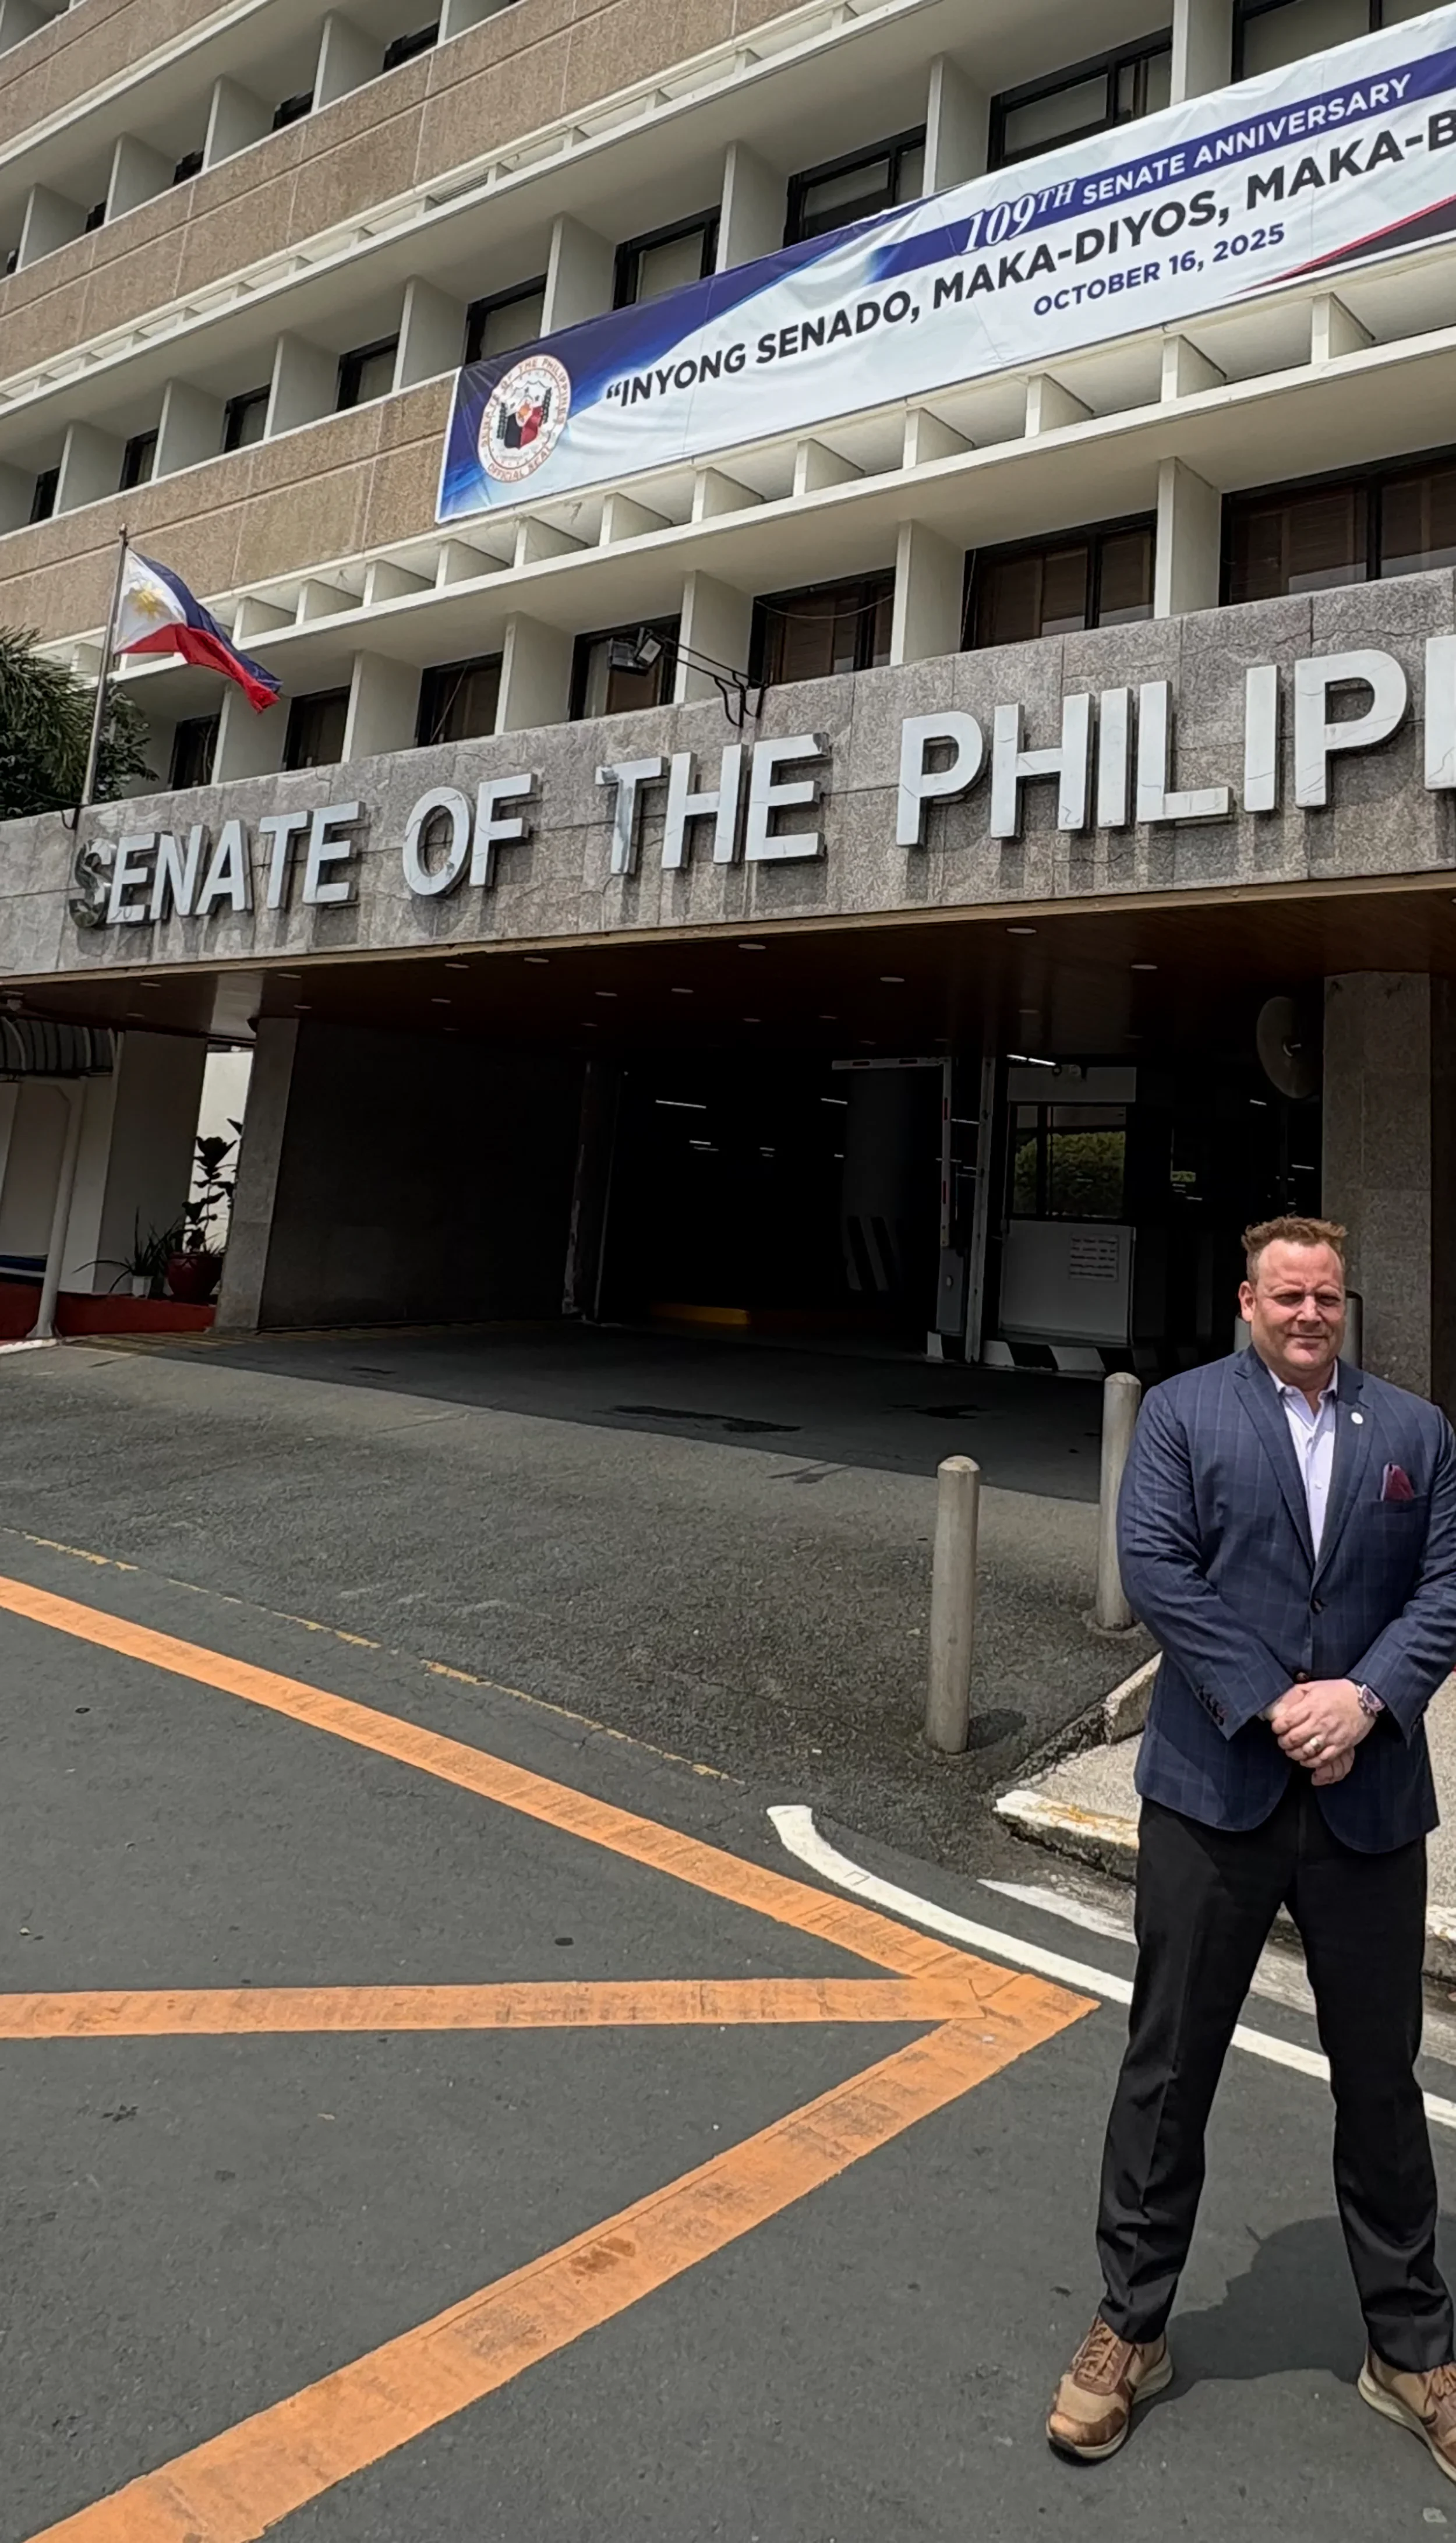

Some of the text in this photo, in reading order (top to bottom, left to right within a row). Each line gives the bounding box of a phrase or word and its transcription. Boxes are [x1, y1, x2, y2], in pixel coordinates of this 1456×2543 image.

[960, 73, 1412, 255] 109TH SENATE ANNIVERSARY
[606, 109, 1456, 407] “INYONG SENADO, MAKA-DIYOS, MAKA-B
[1033, 223, 1285, 316] OCTOBER 16, 2025
[518, 358, 538, 373] THE
[69, 801, 366, 930] SENATE
[402, 774, 538, 898] OF
[595, 732, 830, 874] THE
